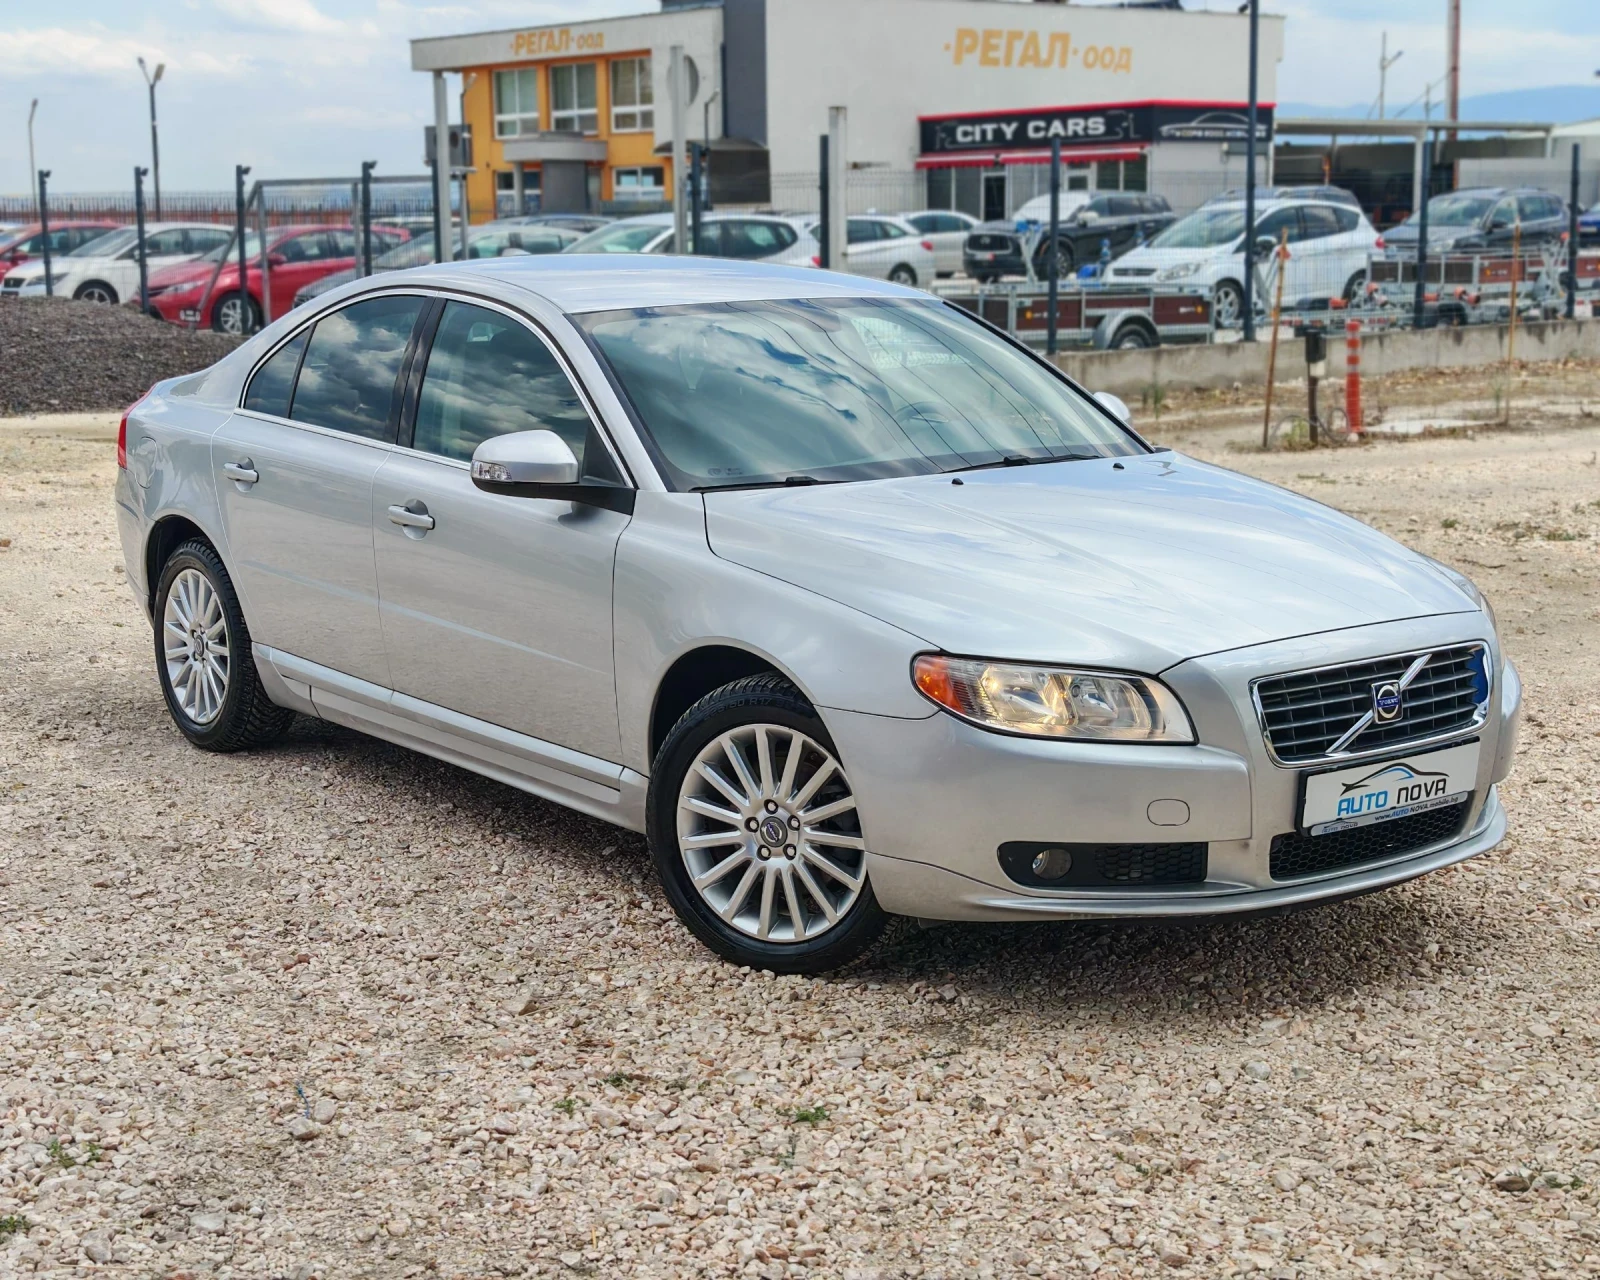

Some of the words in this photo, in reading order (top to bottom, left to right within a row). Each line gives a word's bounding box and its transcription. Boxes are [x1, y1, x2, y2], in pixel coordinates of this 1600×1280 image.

[956, 121, 1019, 143] CITY
[1027, 116, 1106, 139] CARS
[1337, 790, 1388, 816] AUTO
[1396, 778, 1447, 804] NOVA
